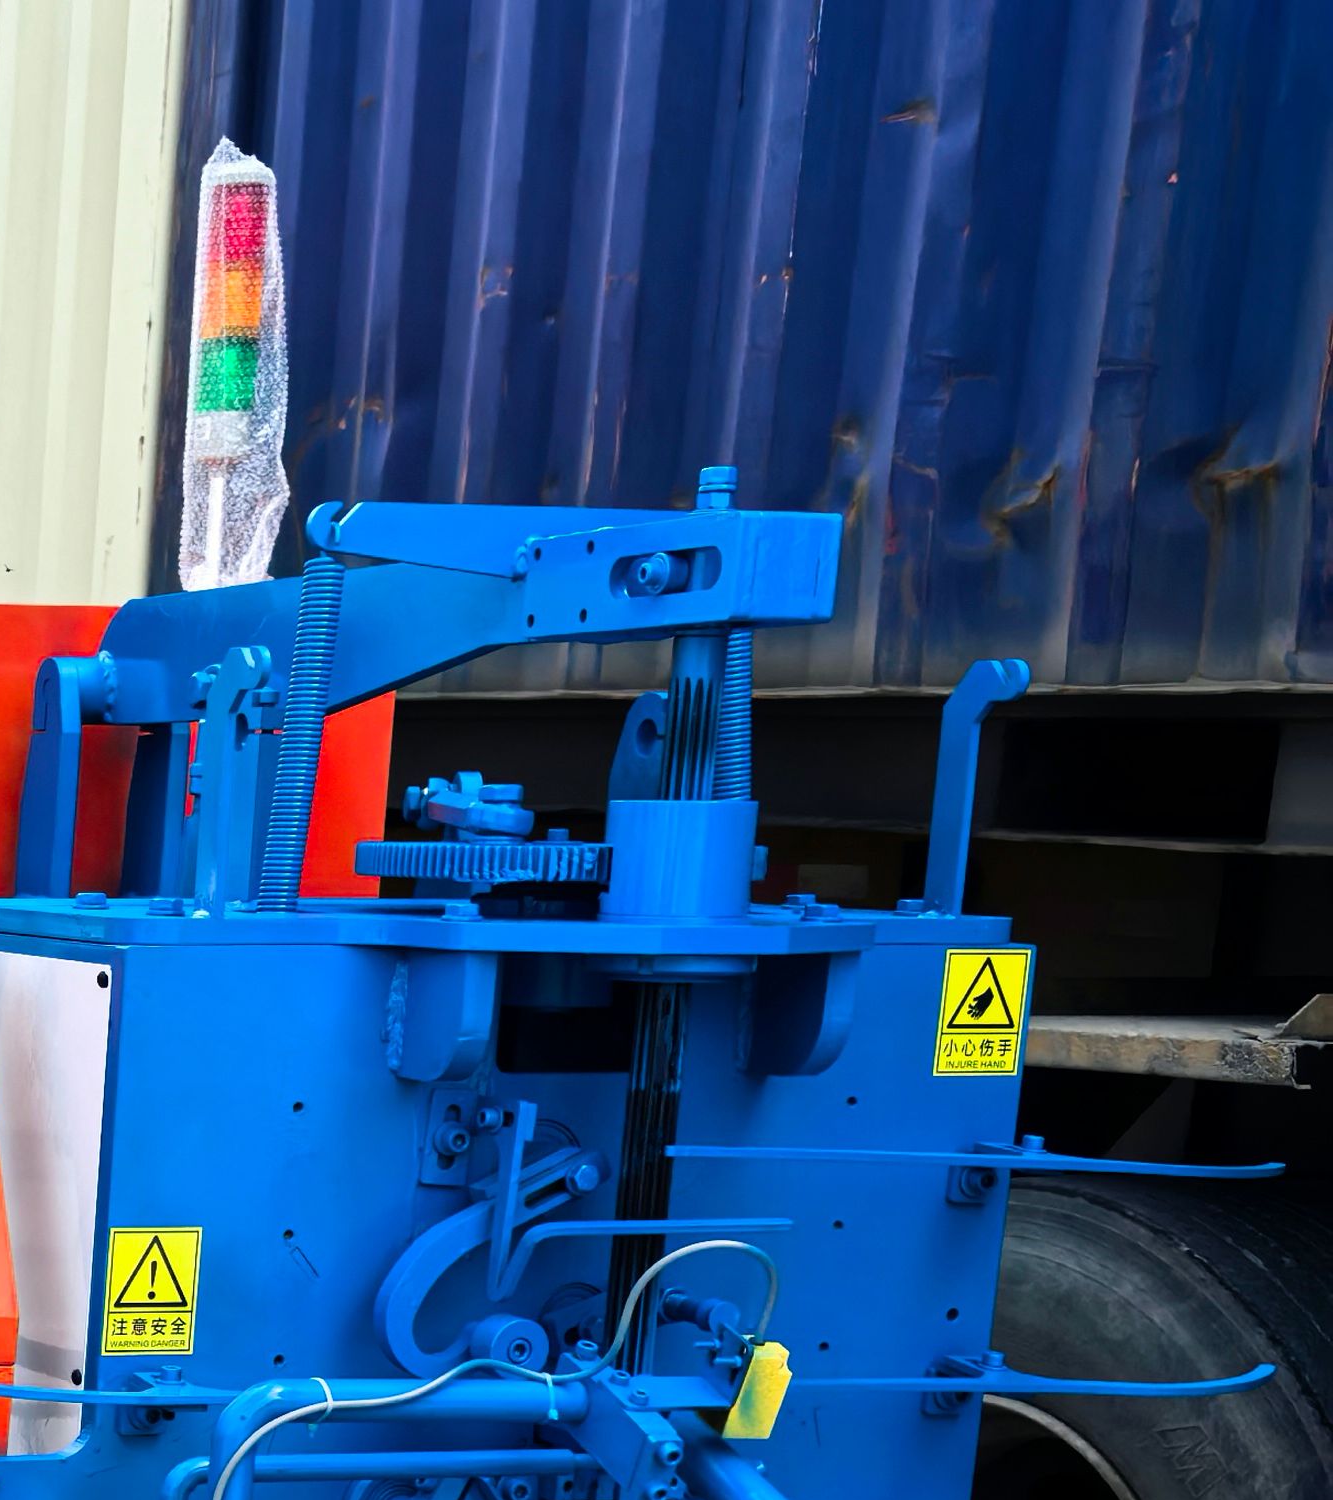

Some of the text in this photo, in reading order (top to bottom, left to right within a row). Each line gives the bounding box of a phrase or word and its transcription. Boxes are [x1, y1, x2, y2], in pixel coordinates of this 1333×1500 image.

[943, 1038, 1013, 1058] 小心伤手
[945, 1059, 1007, 1069] INJURE HAND
[111, 1317, 187, 1337] 注意安全
[109, 1339, 186, 1348] WARNING DANGER
